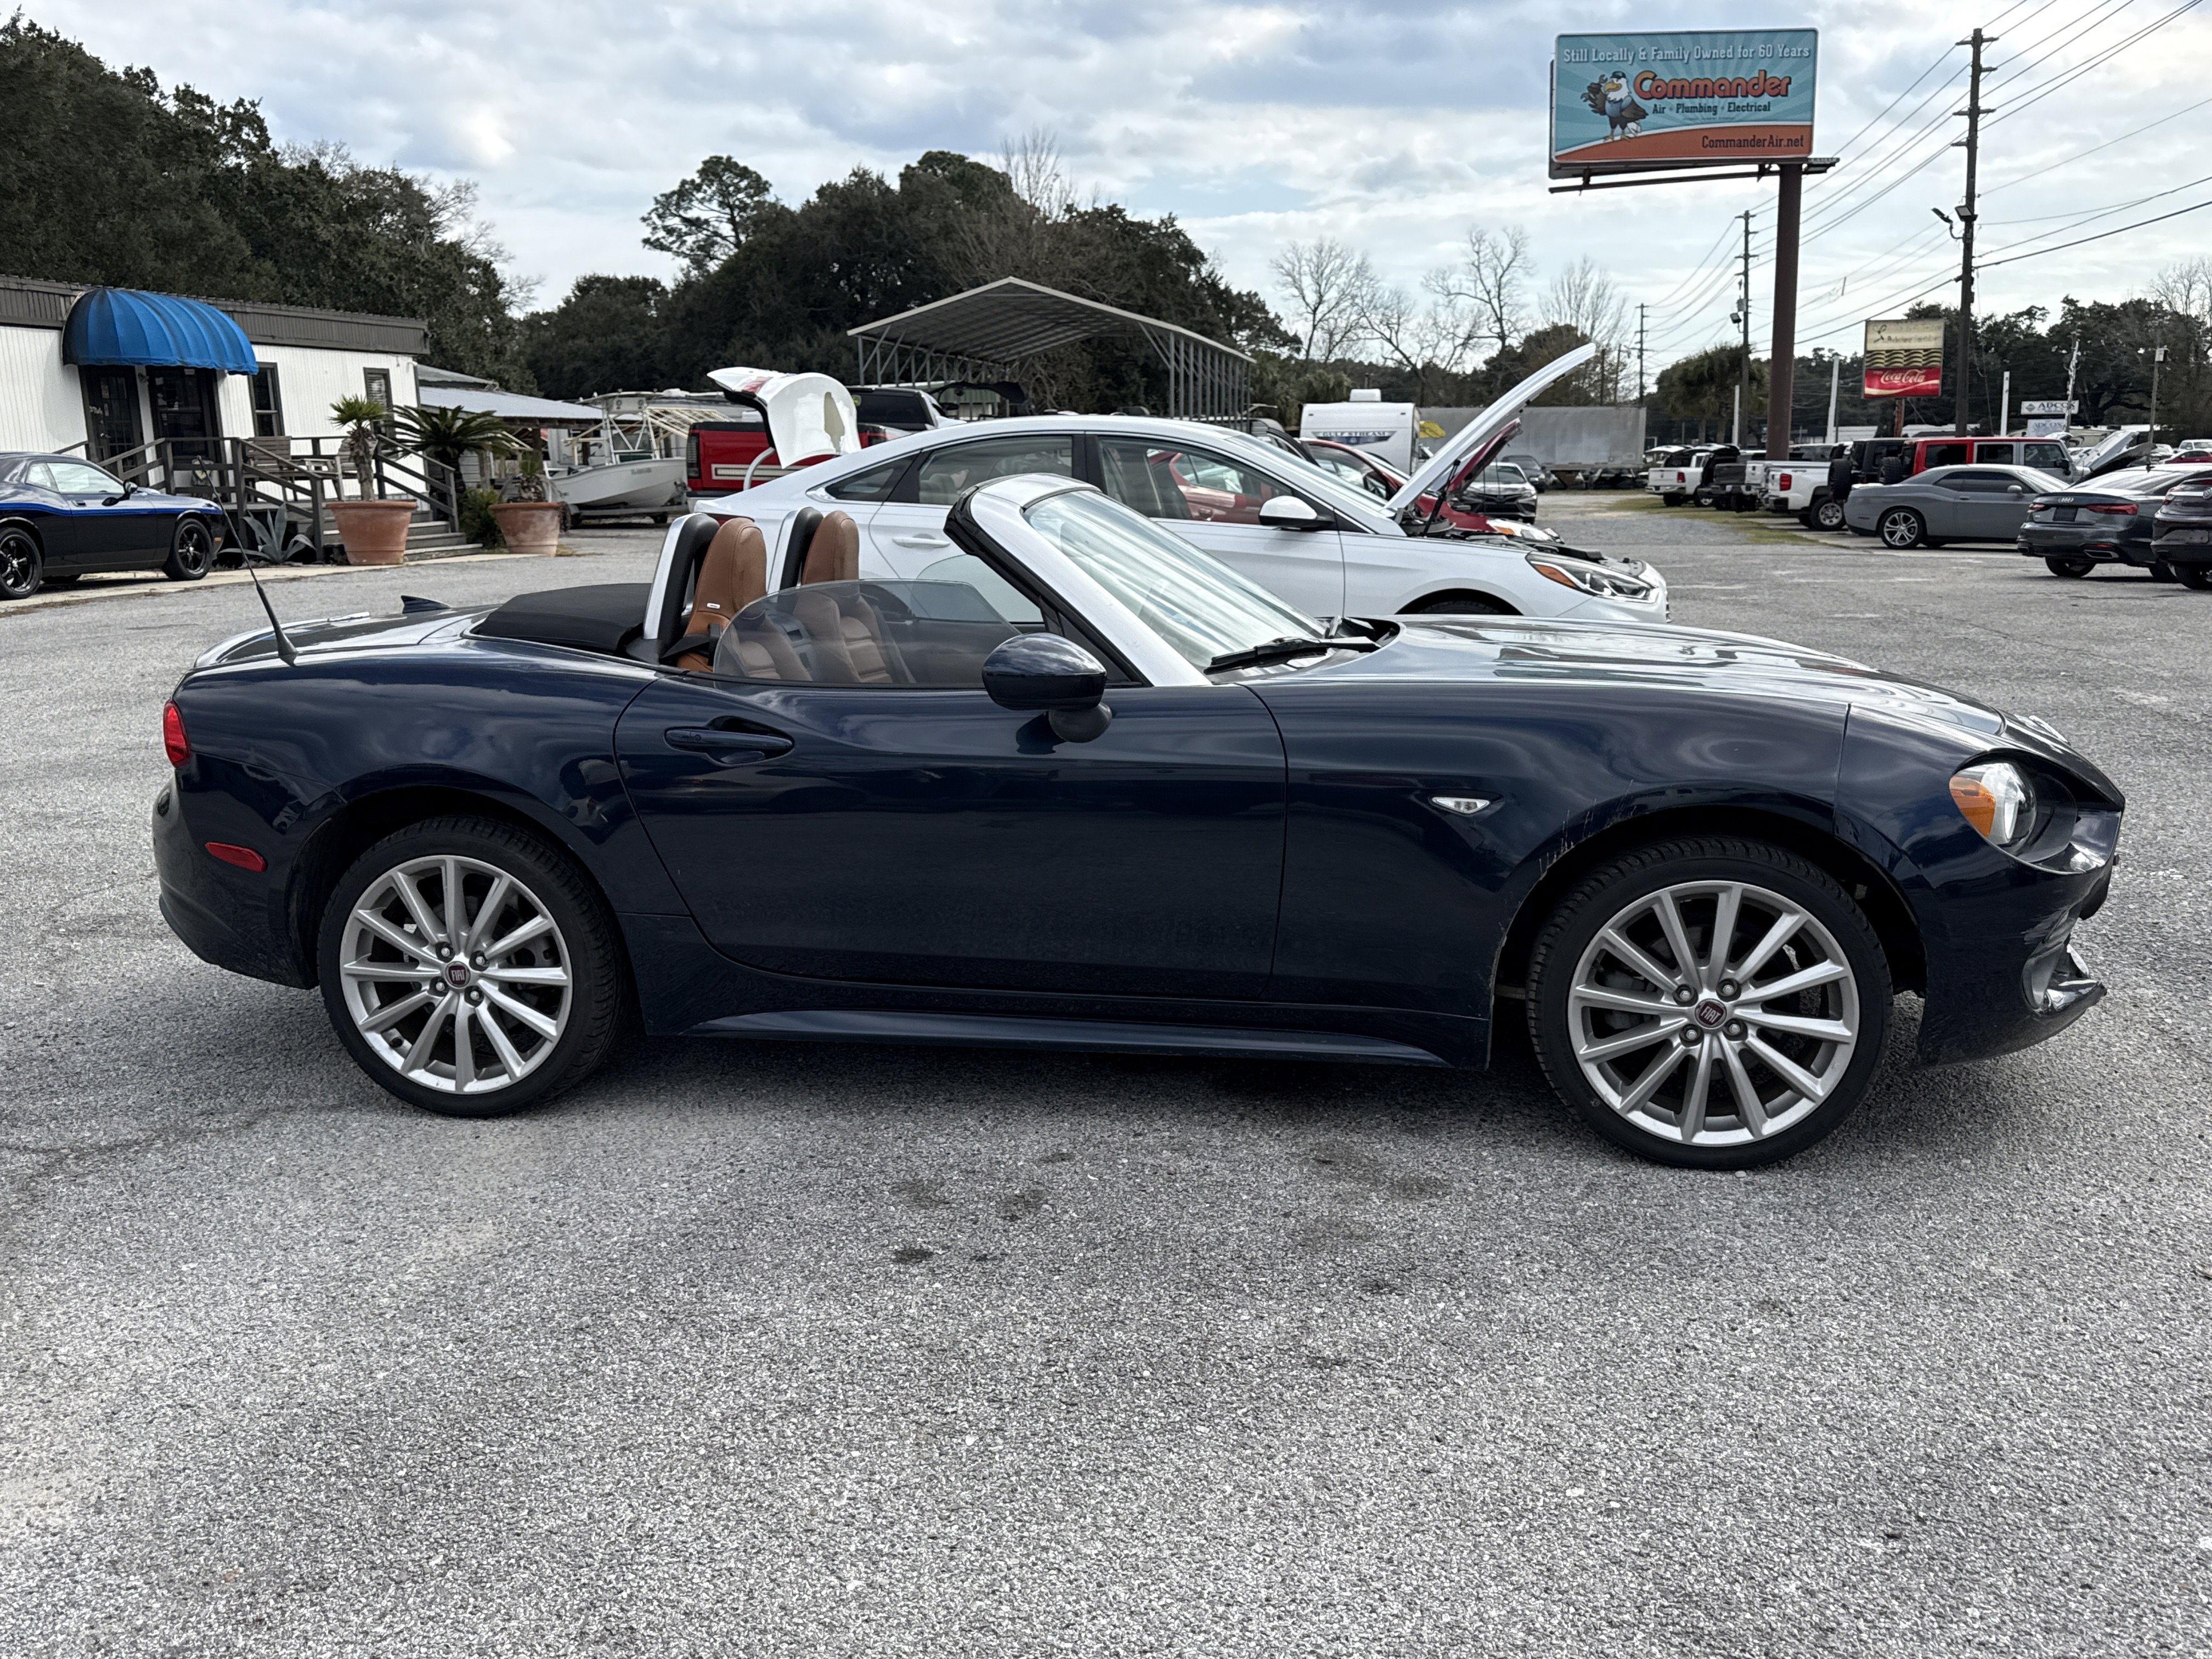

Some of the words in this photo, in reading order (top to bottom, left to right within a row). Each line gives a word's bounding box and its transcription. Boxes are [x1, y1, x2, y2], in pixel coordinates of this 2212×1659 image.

[1564, 48, 1588, 62] Still
[1592, 48, 1634, 65] Locally
[1638, 47, 1646, 60] &
[1651, 46, 1690, 64] Family
[1694, 45, 1733, 59] Owned
[1737, 45, 1755, 58] for
[1758, 44, 1773, 58] 60
[1777, 44, 1810, 58] Years
[1633, 70, 1792, 100] Commander
[1652, 104, 1666, 114] Air
[1675, 103, 1718, 115] Plumbing
[1728, 101, 1771, 113] Electrical
[1702, 135, 1804, 149] CommanderAir.net
[451, 969, 465, 981] FIAT
[1701, 1006, 1721, 1023] FIAT
